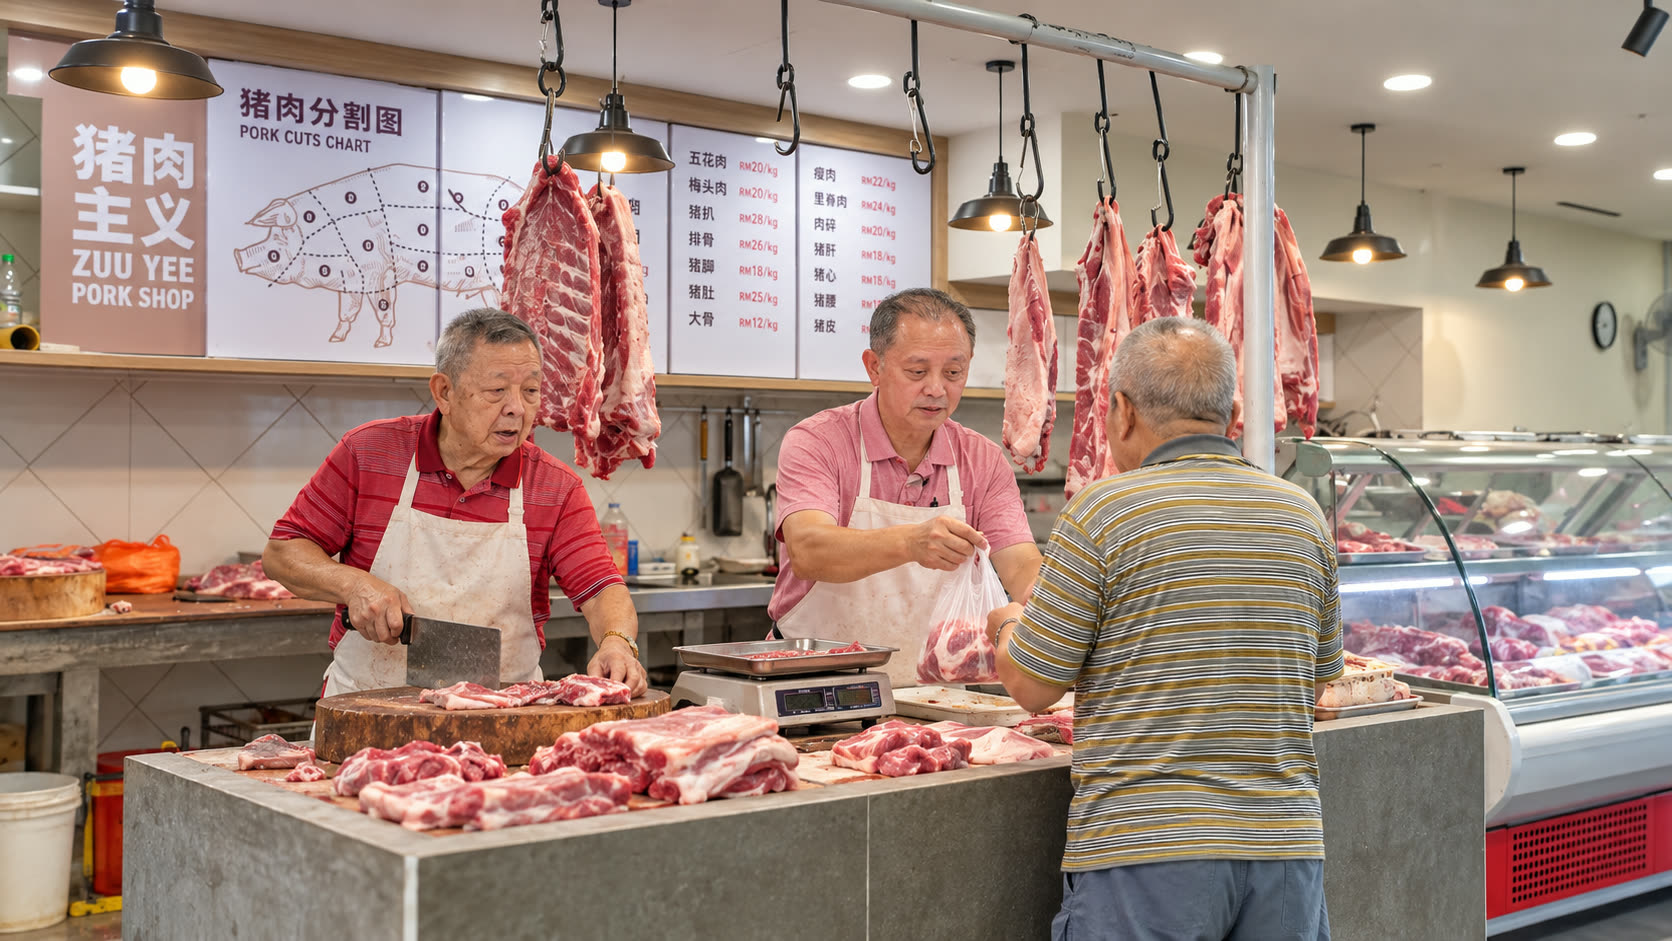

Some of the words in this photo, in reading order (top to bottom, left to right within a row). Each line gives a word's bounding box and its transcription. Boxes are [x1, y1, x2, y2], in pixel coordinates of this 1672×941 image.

[239, 87, 403, 137] 猪肉分割图
[239, 124, 280, 143] PORK
[284, 129, 321, 148] CUTS
[325, 135, 372, 154] CHART
[72, 123, 195, 190] 猪肉
[688, 150, 728, 170] 五花肉
[738, 160, 779, 178] RM20/kg
[813, 166, 837, 183] 瘦肉
[688, 176, 728, 197] 梅头肉
[860, 175, 897, 193] RM22/kg
[738, 186, 779, 204] RM20/kg
[813, 191, 848, 209] 里脊肉
[688, 204, 715, 222] 猪扒
[860, 200, 897, 217] RM24/kg
[72, 186, 195, 250] 主义
[738, 212, 779, 230] RM28/kg
[688, 230, 715, 248] 排骨
[860, 225, 897, 241] RM20/kg
[738, 238, 779, 256] RM26/kg
[813, 242, 837, 258] 猪肝
[71, 248, 133, 280] ZUU
[141, 254, 195, 283] YEE
[688, 257, 715, 274] 猪脚
[860, 249, 897, 265] RM18/kg
[738, 264, 779, 281] RM18/kg
[813, 267, 837, 283] 猪心
[71, 282, 133, 308] PORK
[138, 286, 194, 310] SHOP
[688, 283, 715, 300] 猪肚
[738, 290, 779, 307] RM25/kg
[688, 310, 715, 328] 大骨
[738, 316, 779, 333] RM12/kg
[813, 318, 837, 334] 猪皮
